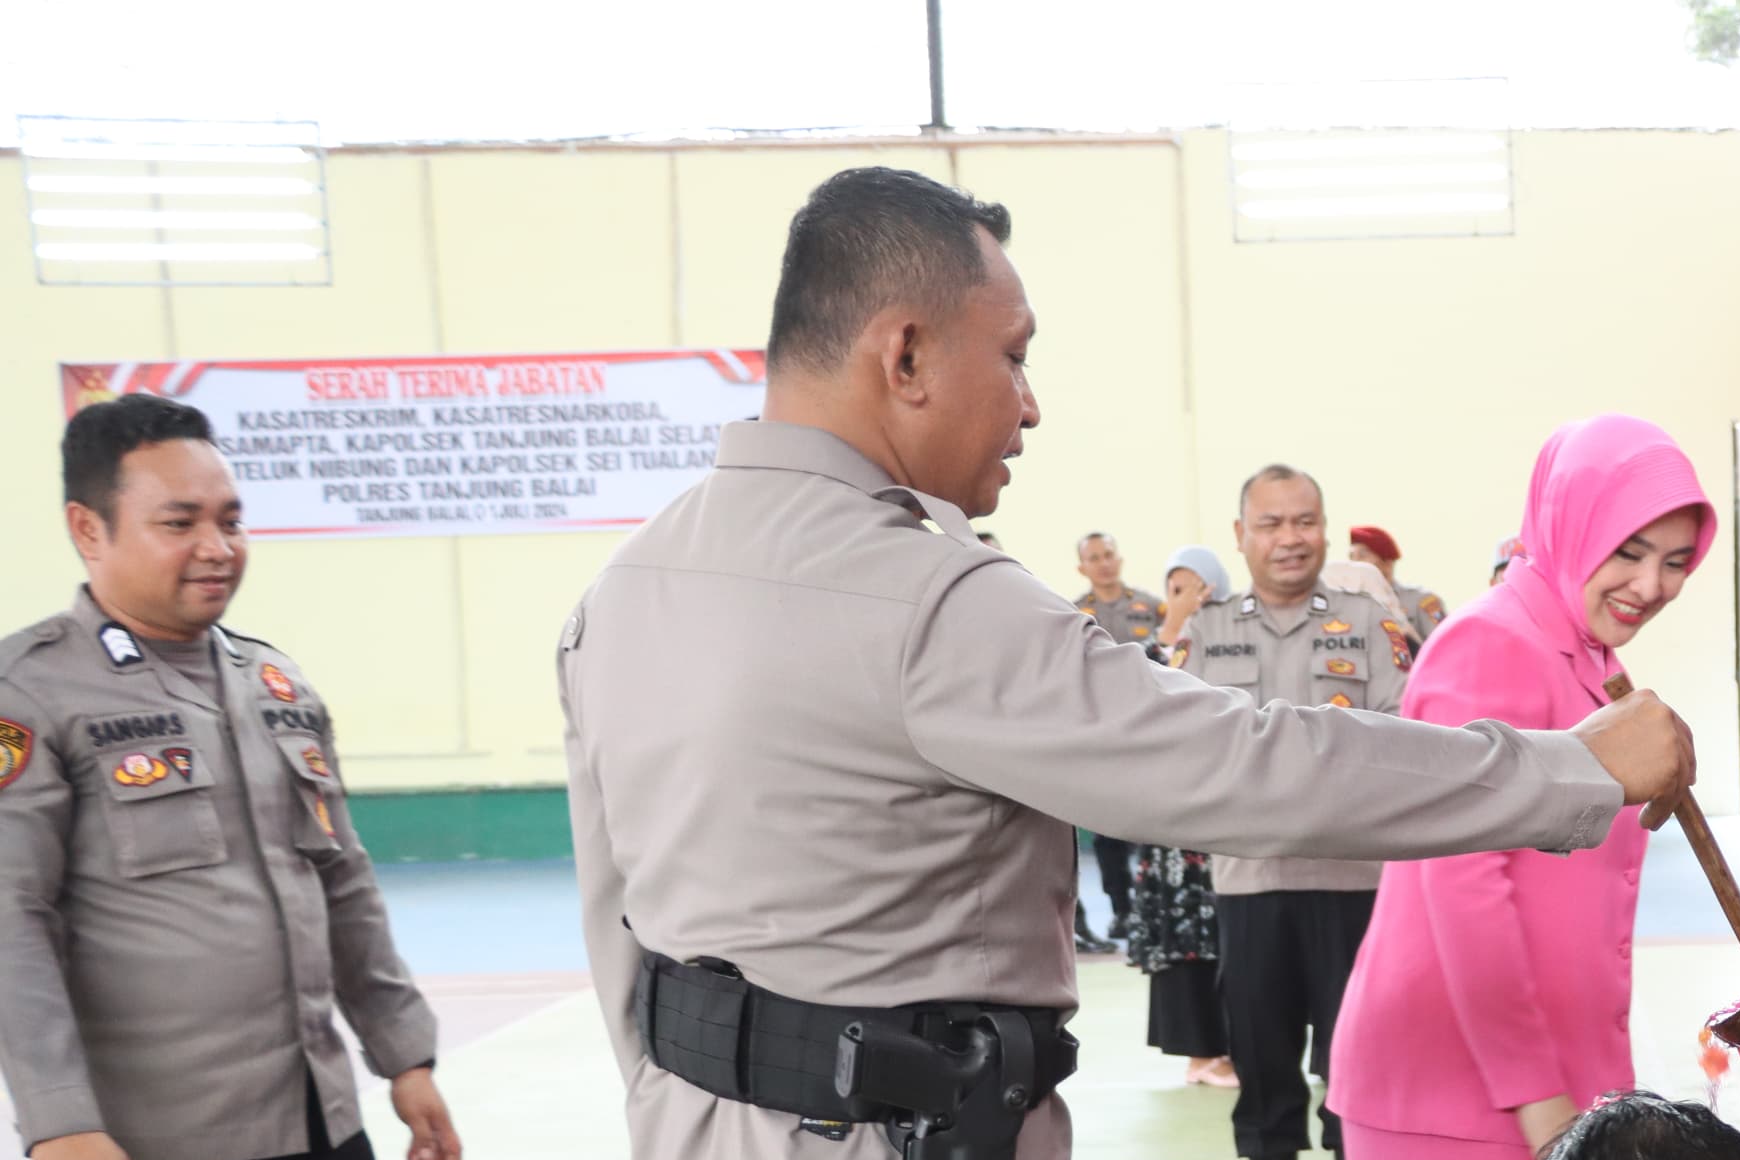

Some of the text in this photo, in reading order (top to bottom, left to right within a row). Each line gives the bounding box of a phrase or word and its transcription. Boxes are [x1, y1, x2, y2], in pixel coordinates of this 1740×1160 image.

[306, 363, 606, 401] SERAH TERIMA JABATAN
[345, 430, 464, 453] KAPOLSEK
[473, 427, 578, 450] TANJUNG
[586, 425, 650, 447] BALAI
[231, 460, 302, 481] TELUK
[309, 458, 398, 479] NIBUNG
[405, 456, 452, 476] DAN
[460, 453, 578, 475] KAPOLSEK
[586, 451, 622, 472] SEI
[323, 476, 597, 503] POLRES TANJUNG BALAI
[1204, 643, 1257, 659] HENDRI
[1312, 636, 1366, 651] POLRI
